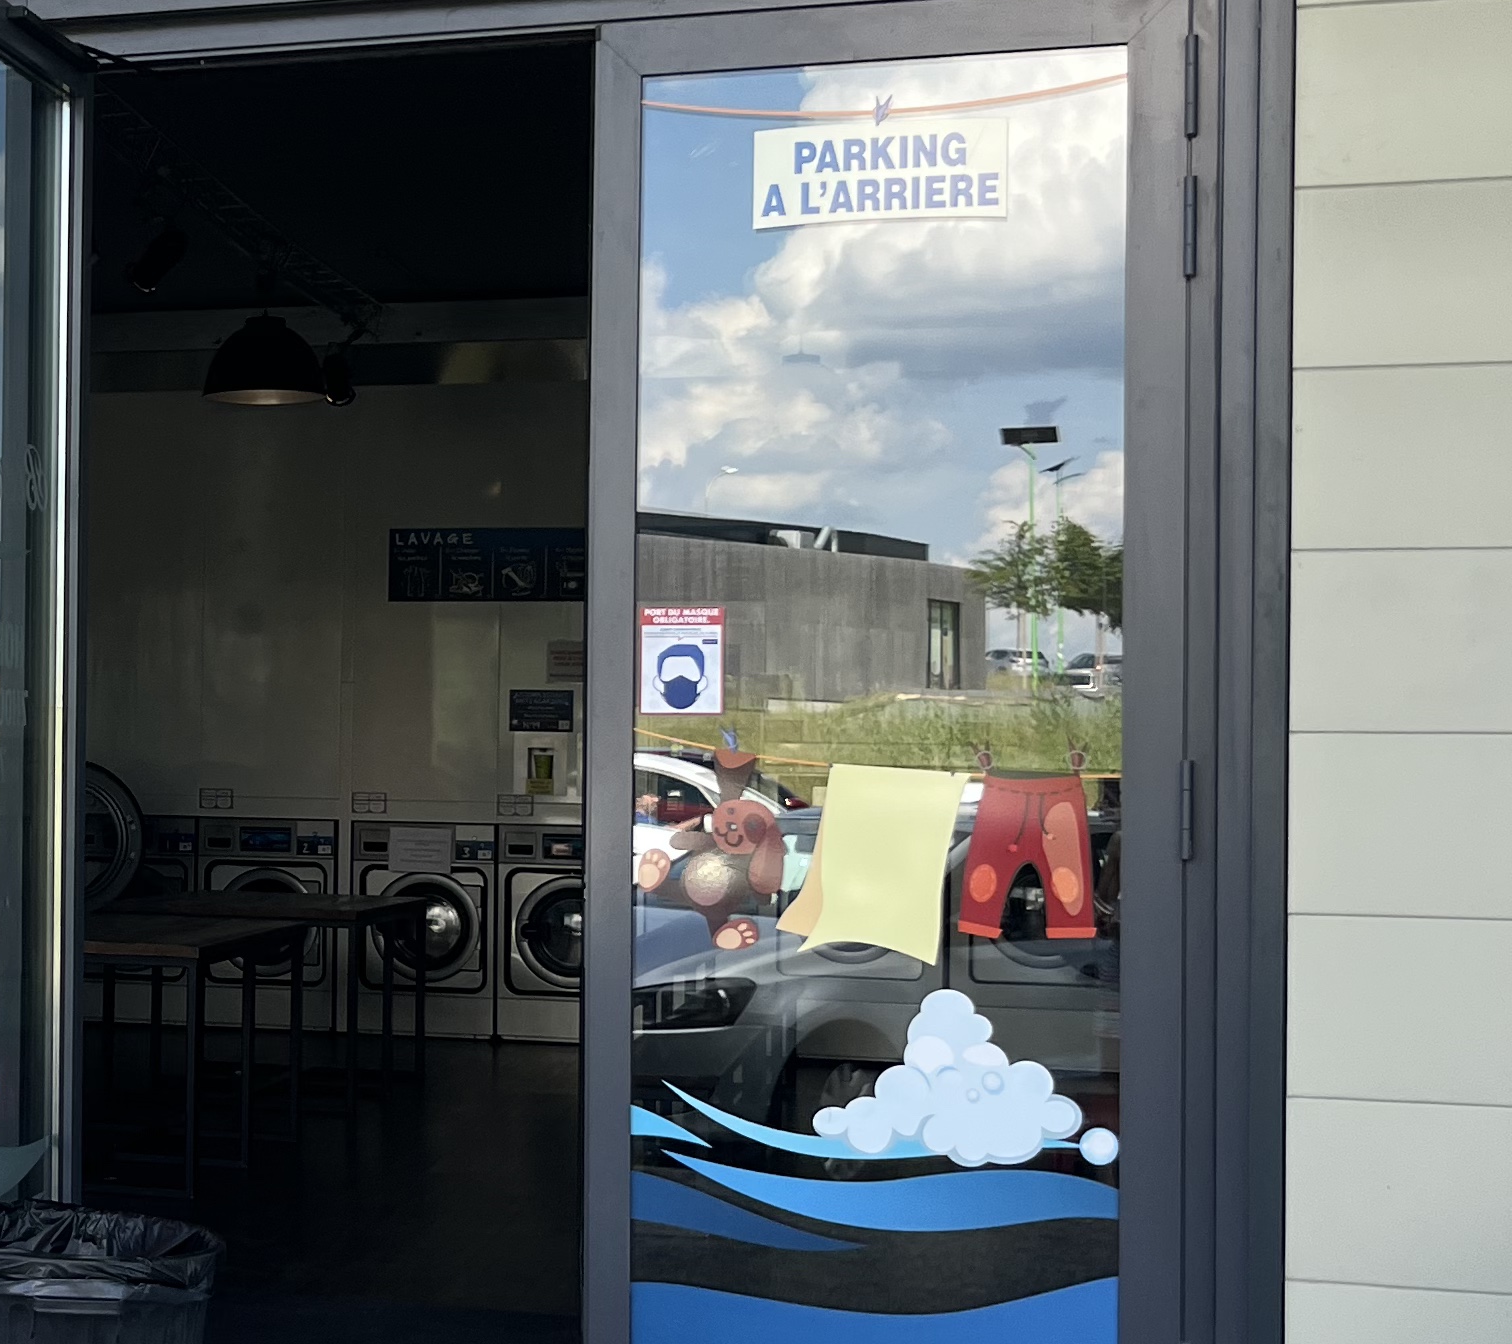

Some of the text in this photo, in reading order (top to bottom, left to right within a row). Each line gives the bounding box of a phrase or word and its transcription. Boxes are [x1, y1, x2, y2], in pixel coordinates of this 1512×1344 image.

[794, 132, 967, 174] PARKING
[761, 184, 786, 217] A
[395, 531, 474, 546] LAVAGE
[644, 608, 719, 616] PORT DU MASQUE
[461, 846, 471, 858] 3
